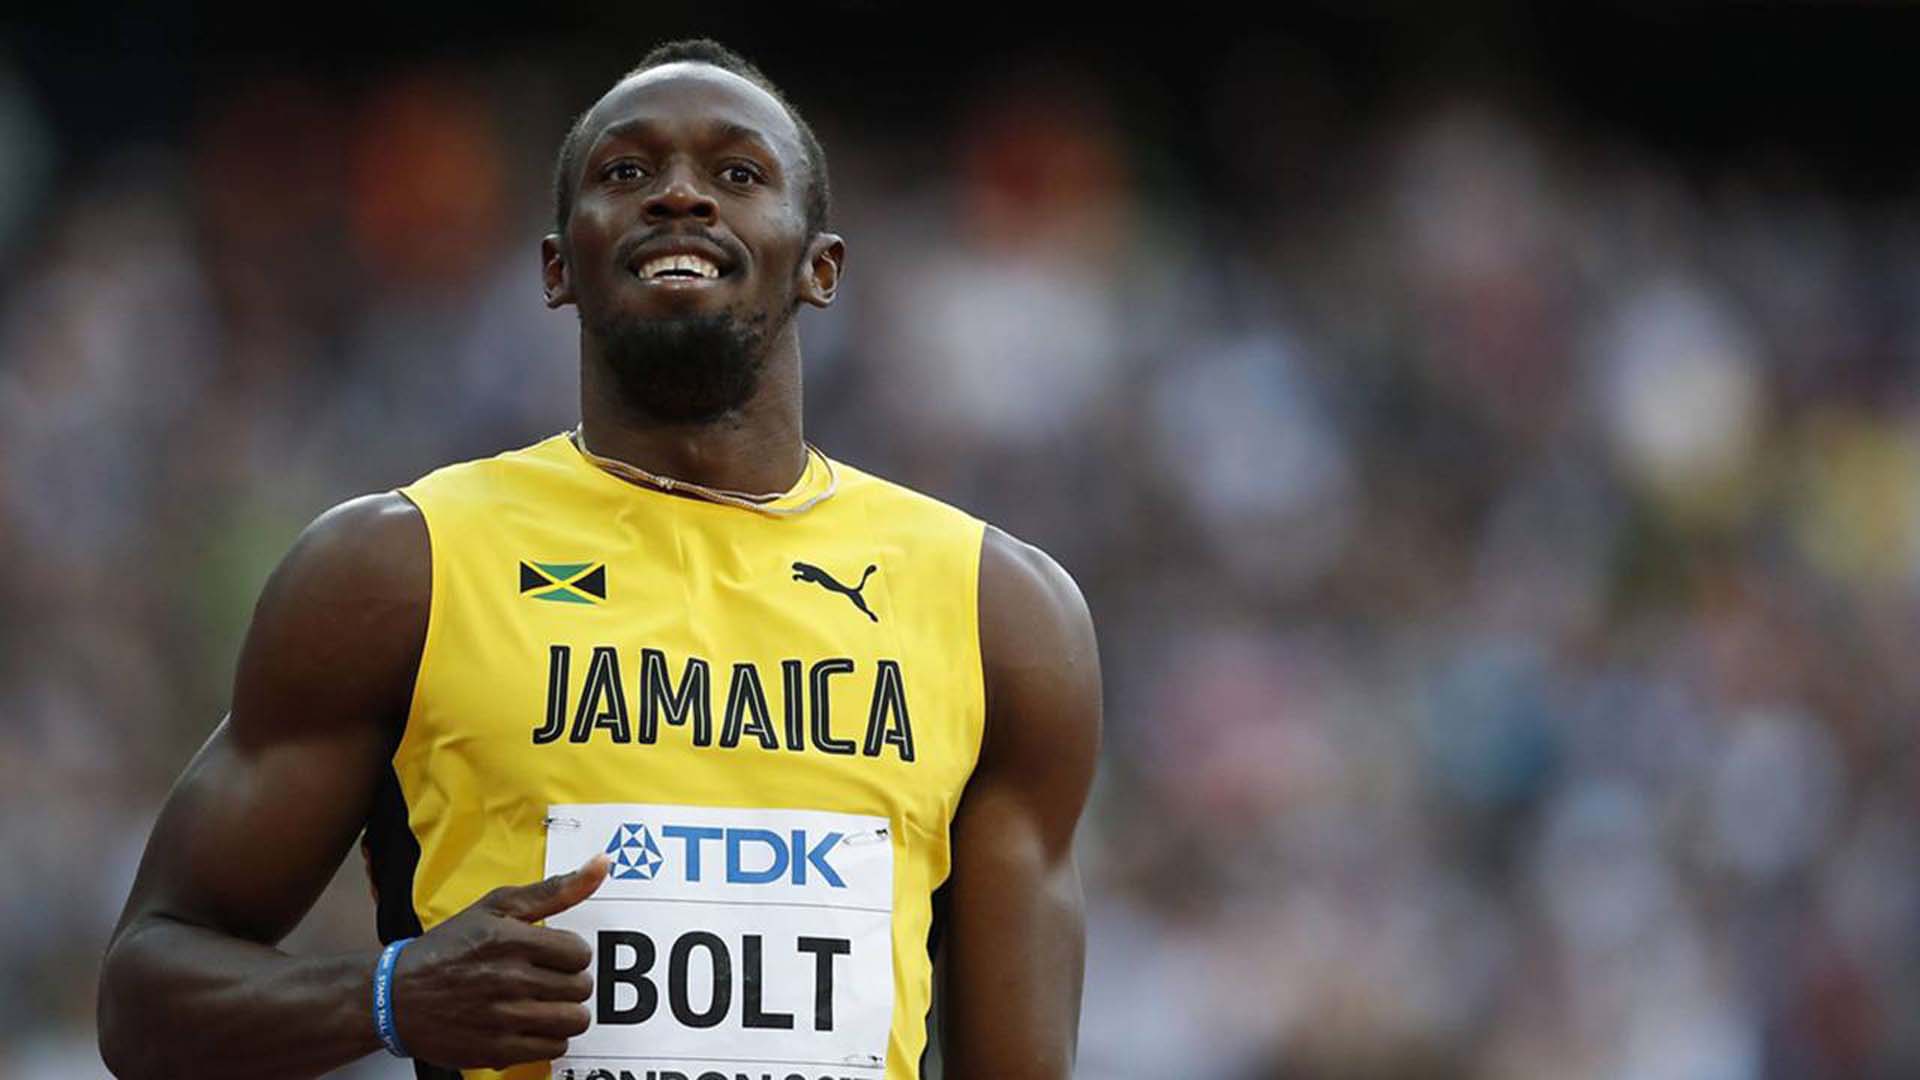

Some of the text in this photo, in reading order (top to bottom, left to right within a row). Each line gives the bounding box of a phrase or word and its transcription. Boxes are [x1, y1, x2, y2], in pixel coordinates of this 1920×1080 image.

[532, 645, 916, 763] JAMAICA
[662, 825, 848, 889] TDK
[377, 975, 386, 1008] STAND
[596, 930, 851, 1032] BOLT
